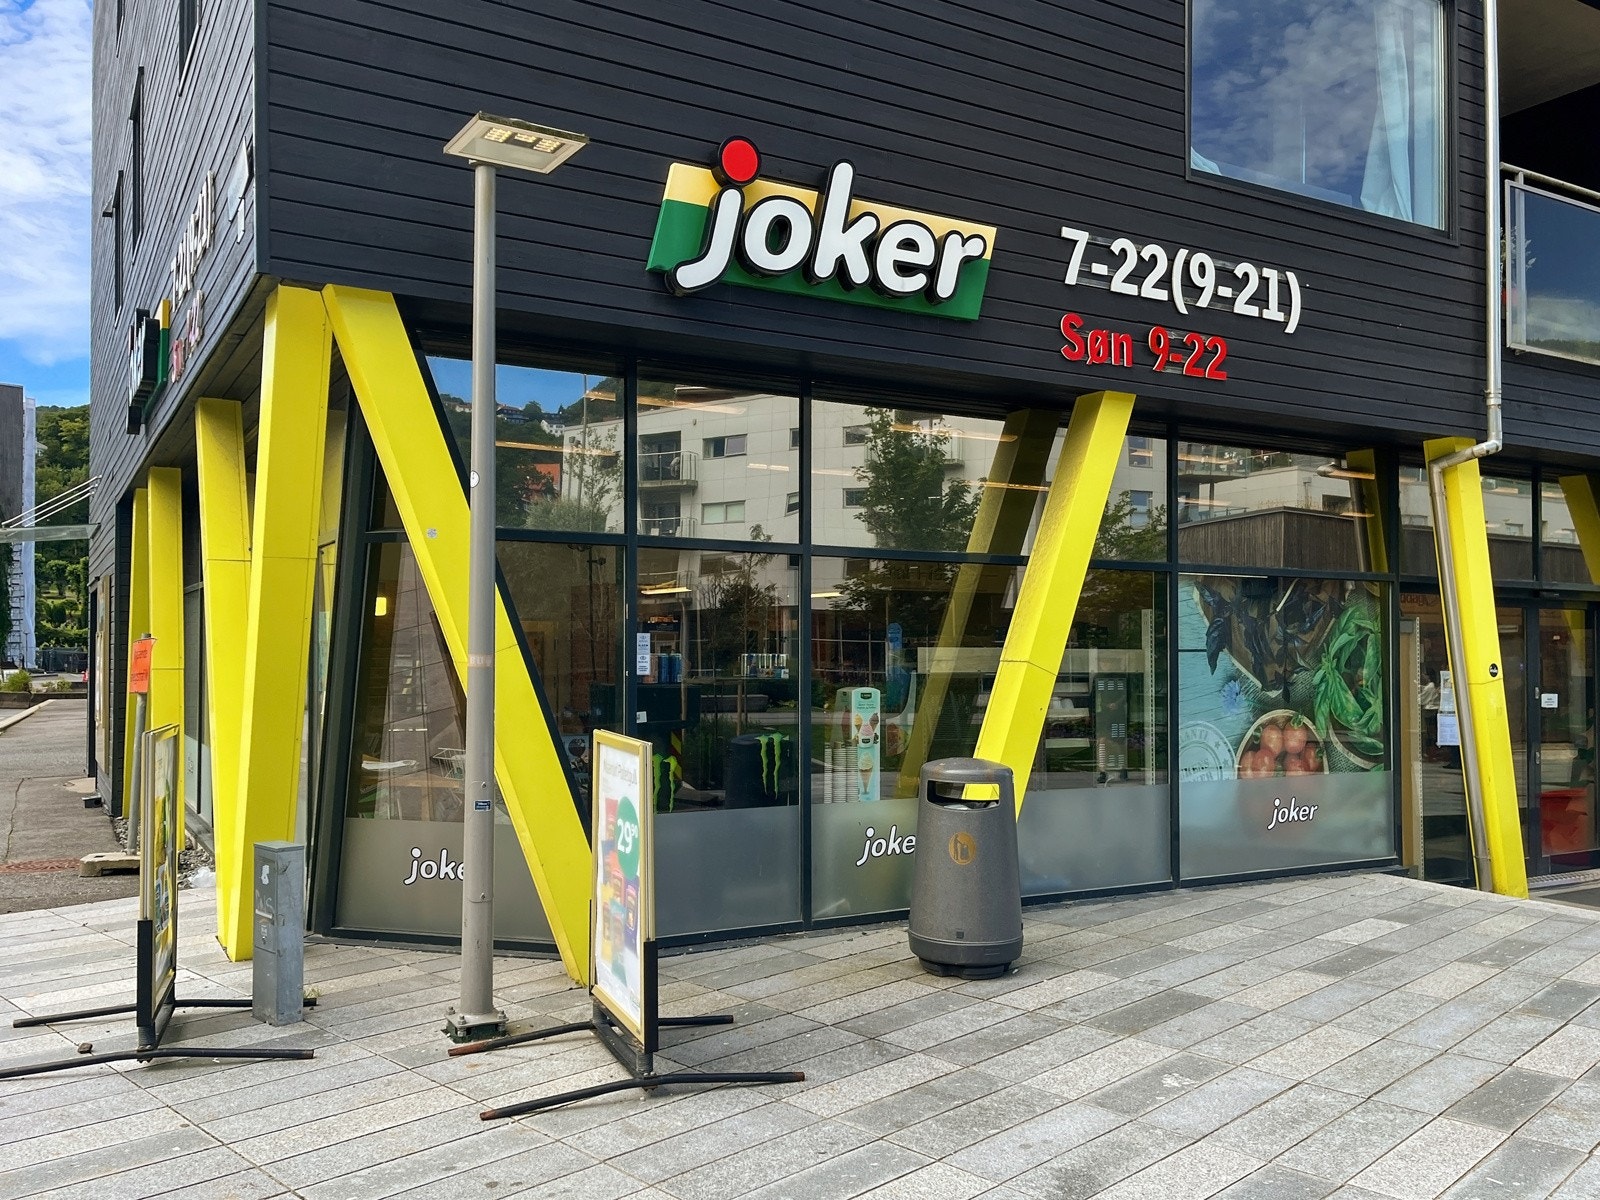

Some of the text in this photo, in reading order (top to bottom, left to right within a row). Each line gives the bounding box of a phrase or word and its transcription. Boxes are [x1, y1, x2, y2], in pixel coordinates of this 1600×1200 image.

[666, 135, 986, 306] joker
[1061, 226, 1301, 333] 7-22(9-21)
[1060, 312, 1228, 381] Søn 9-22
[1267, 796, 1319, 830] joker
[403, 846, 464, 885] jok
[856, 824, 917, 867] joke
